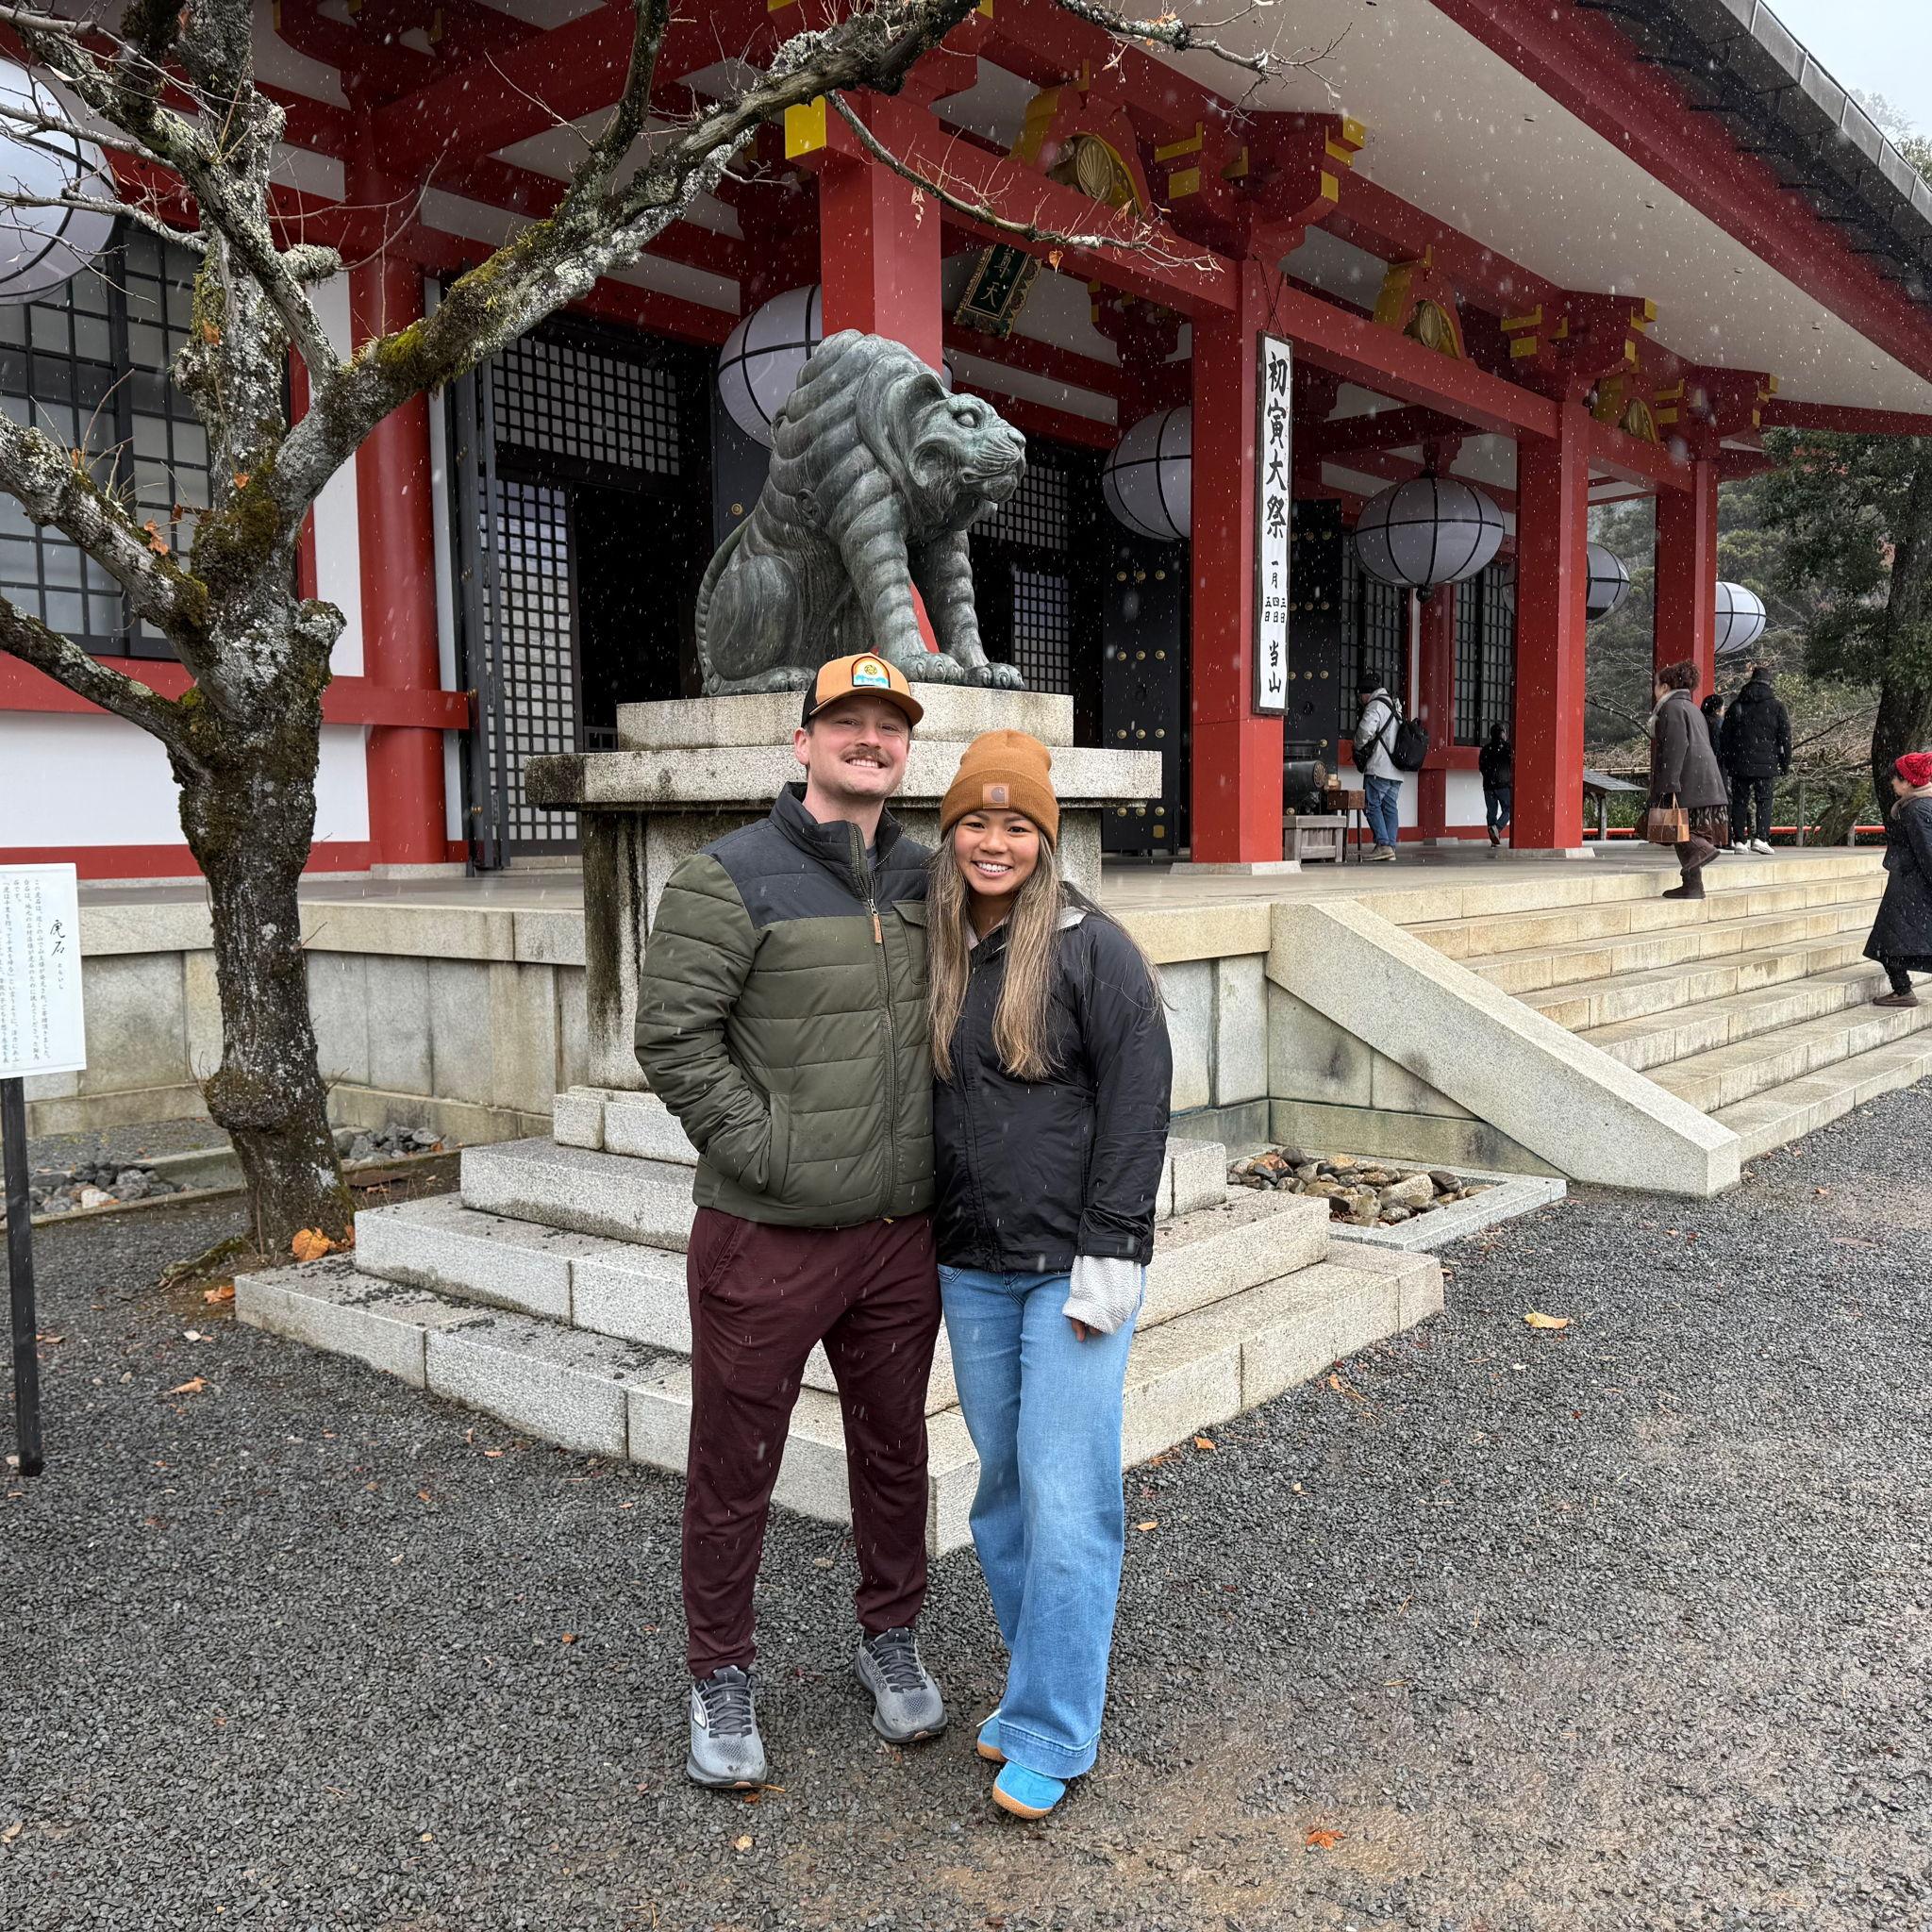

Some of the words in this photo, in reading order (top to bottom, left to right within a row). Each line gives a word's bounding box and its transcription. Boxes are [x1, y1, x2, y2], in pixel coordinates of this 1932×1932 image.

[1265, 350, 1288, 539] 初寅大祭
[1271, 560, 1279, 589] 一月
[1264, 596, 1272, 623] 五日
[1273, 596, 1279, 623] 四日
[1280, 597, 1287, 624] 三日
[1268, 641, 1282, 693] 当山
